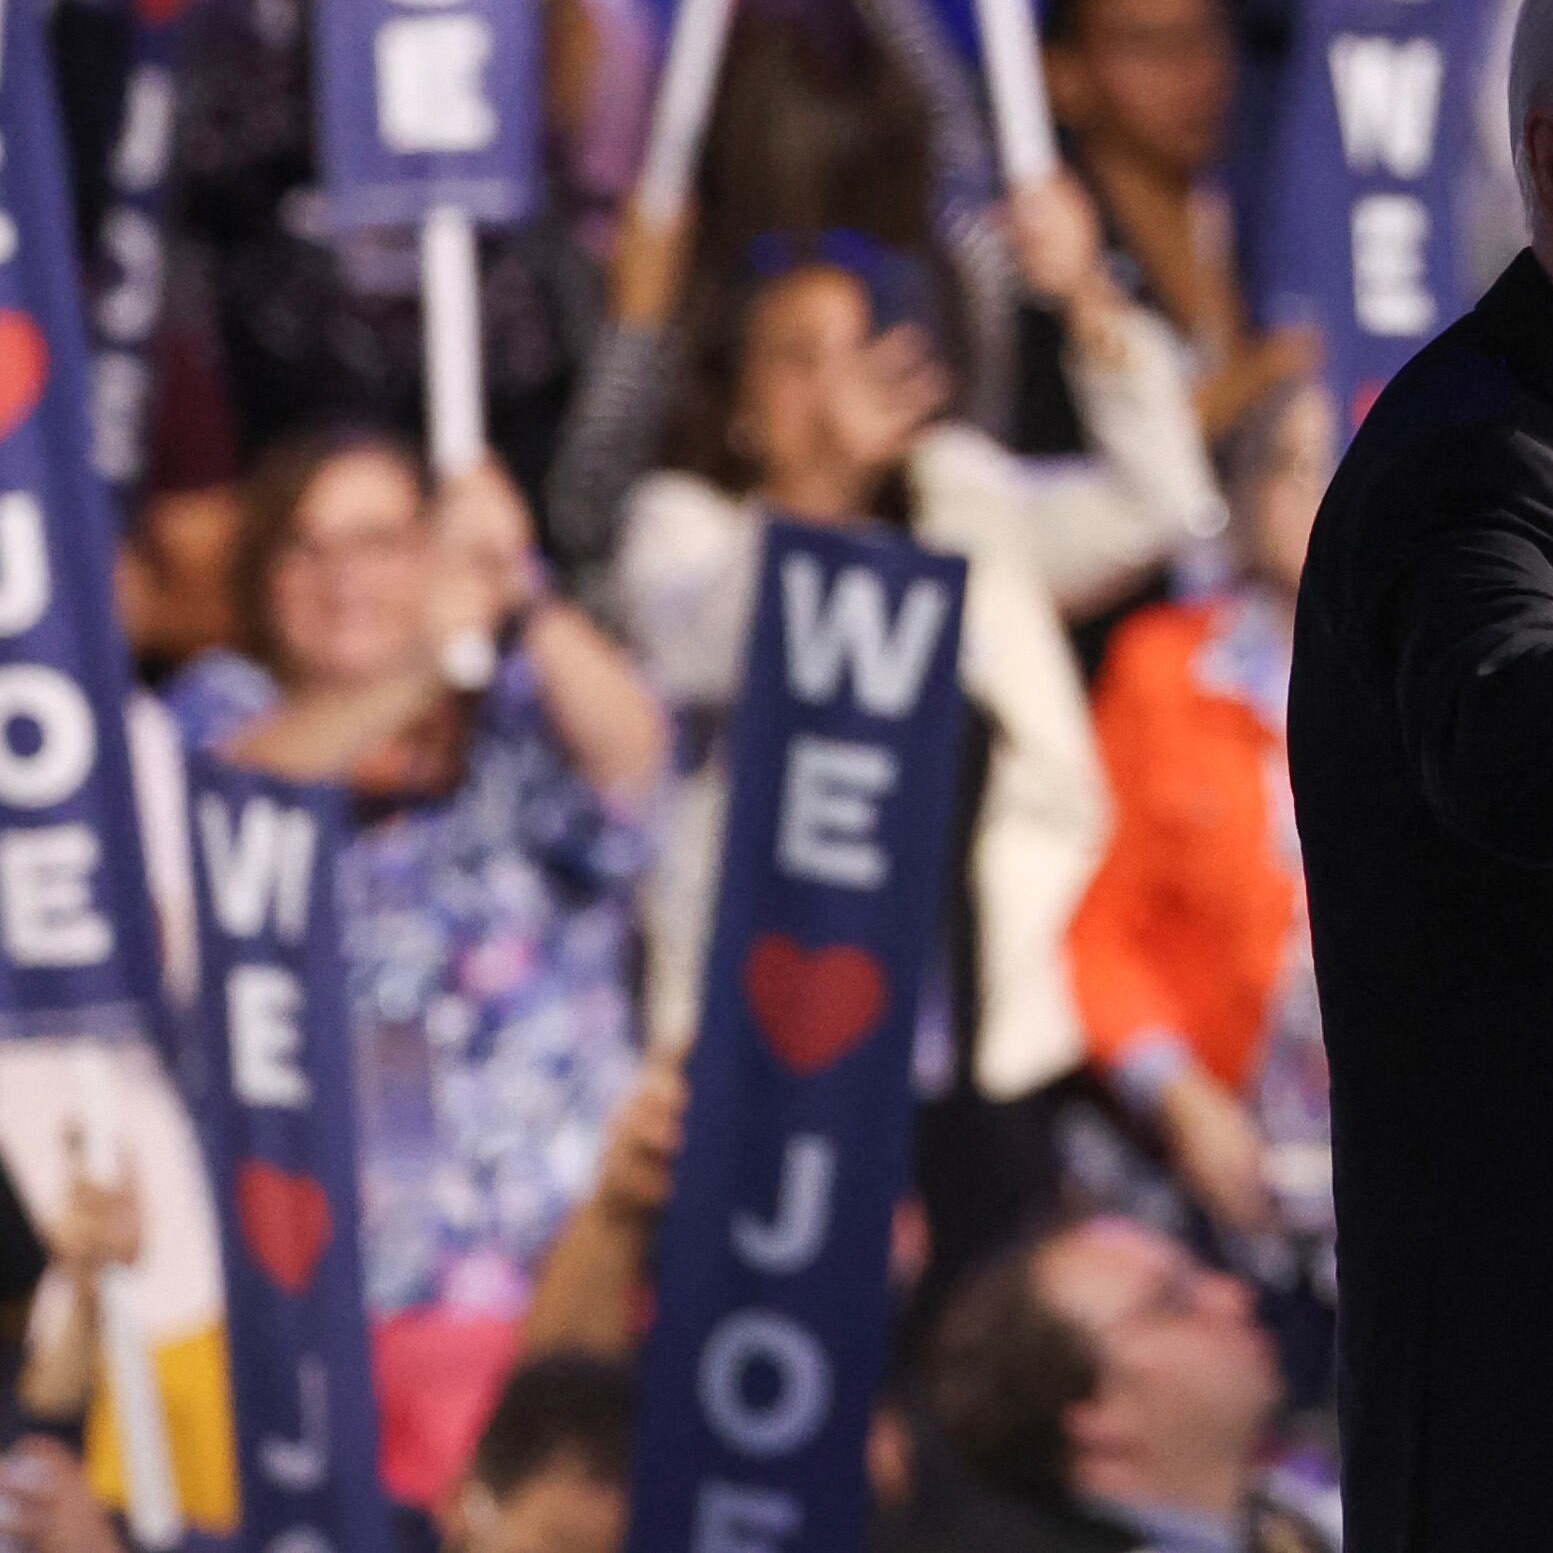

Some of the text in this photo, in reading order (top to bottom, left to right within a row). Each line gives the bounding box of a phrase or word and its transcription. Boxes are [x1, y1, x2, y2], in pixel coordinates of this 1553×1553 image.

[1326, 33, 1444, 338] WE
[775, 553, 950, 890] WE
[202, 790, 318, 1109] WE
